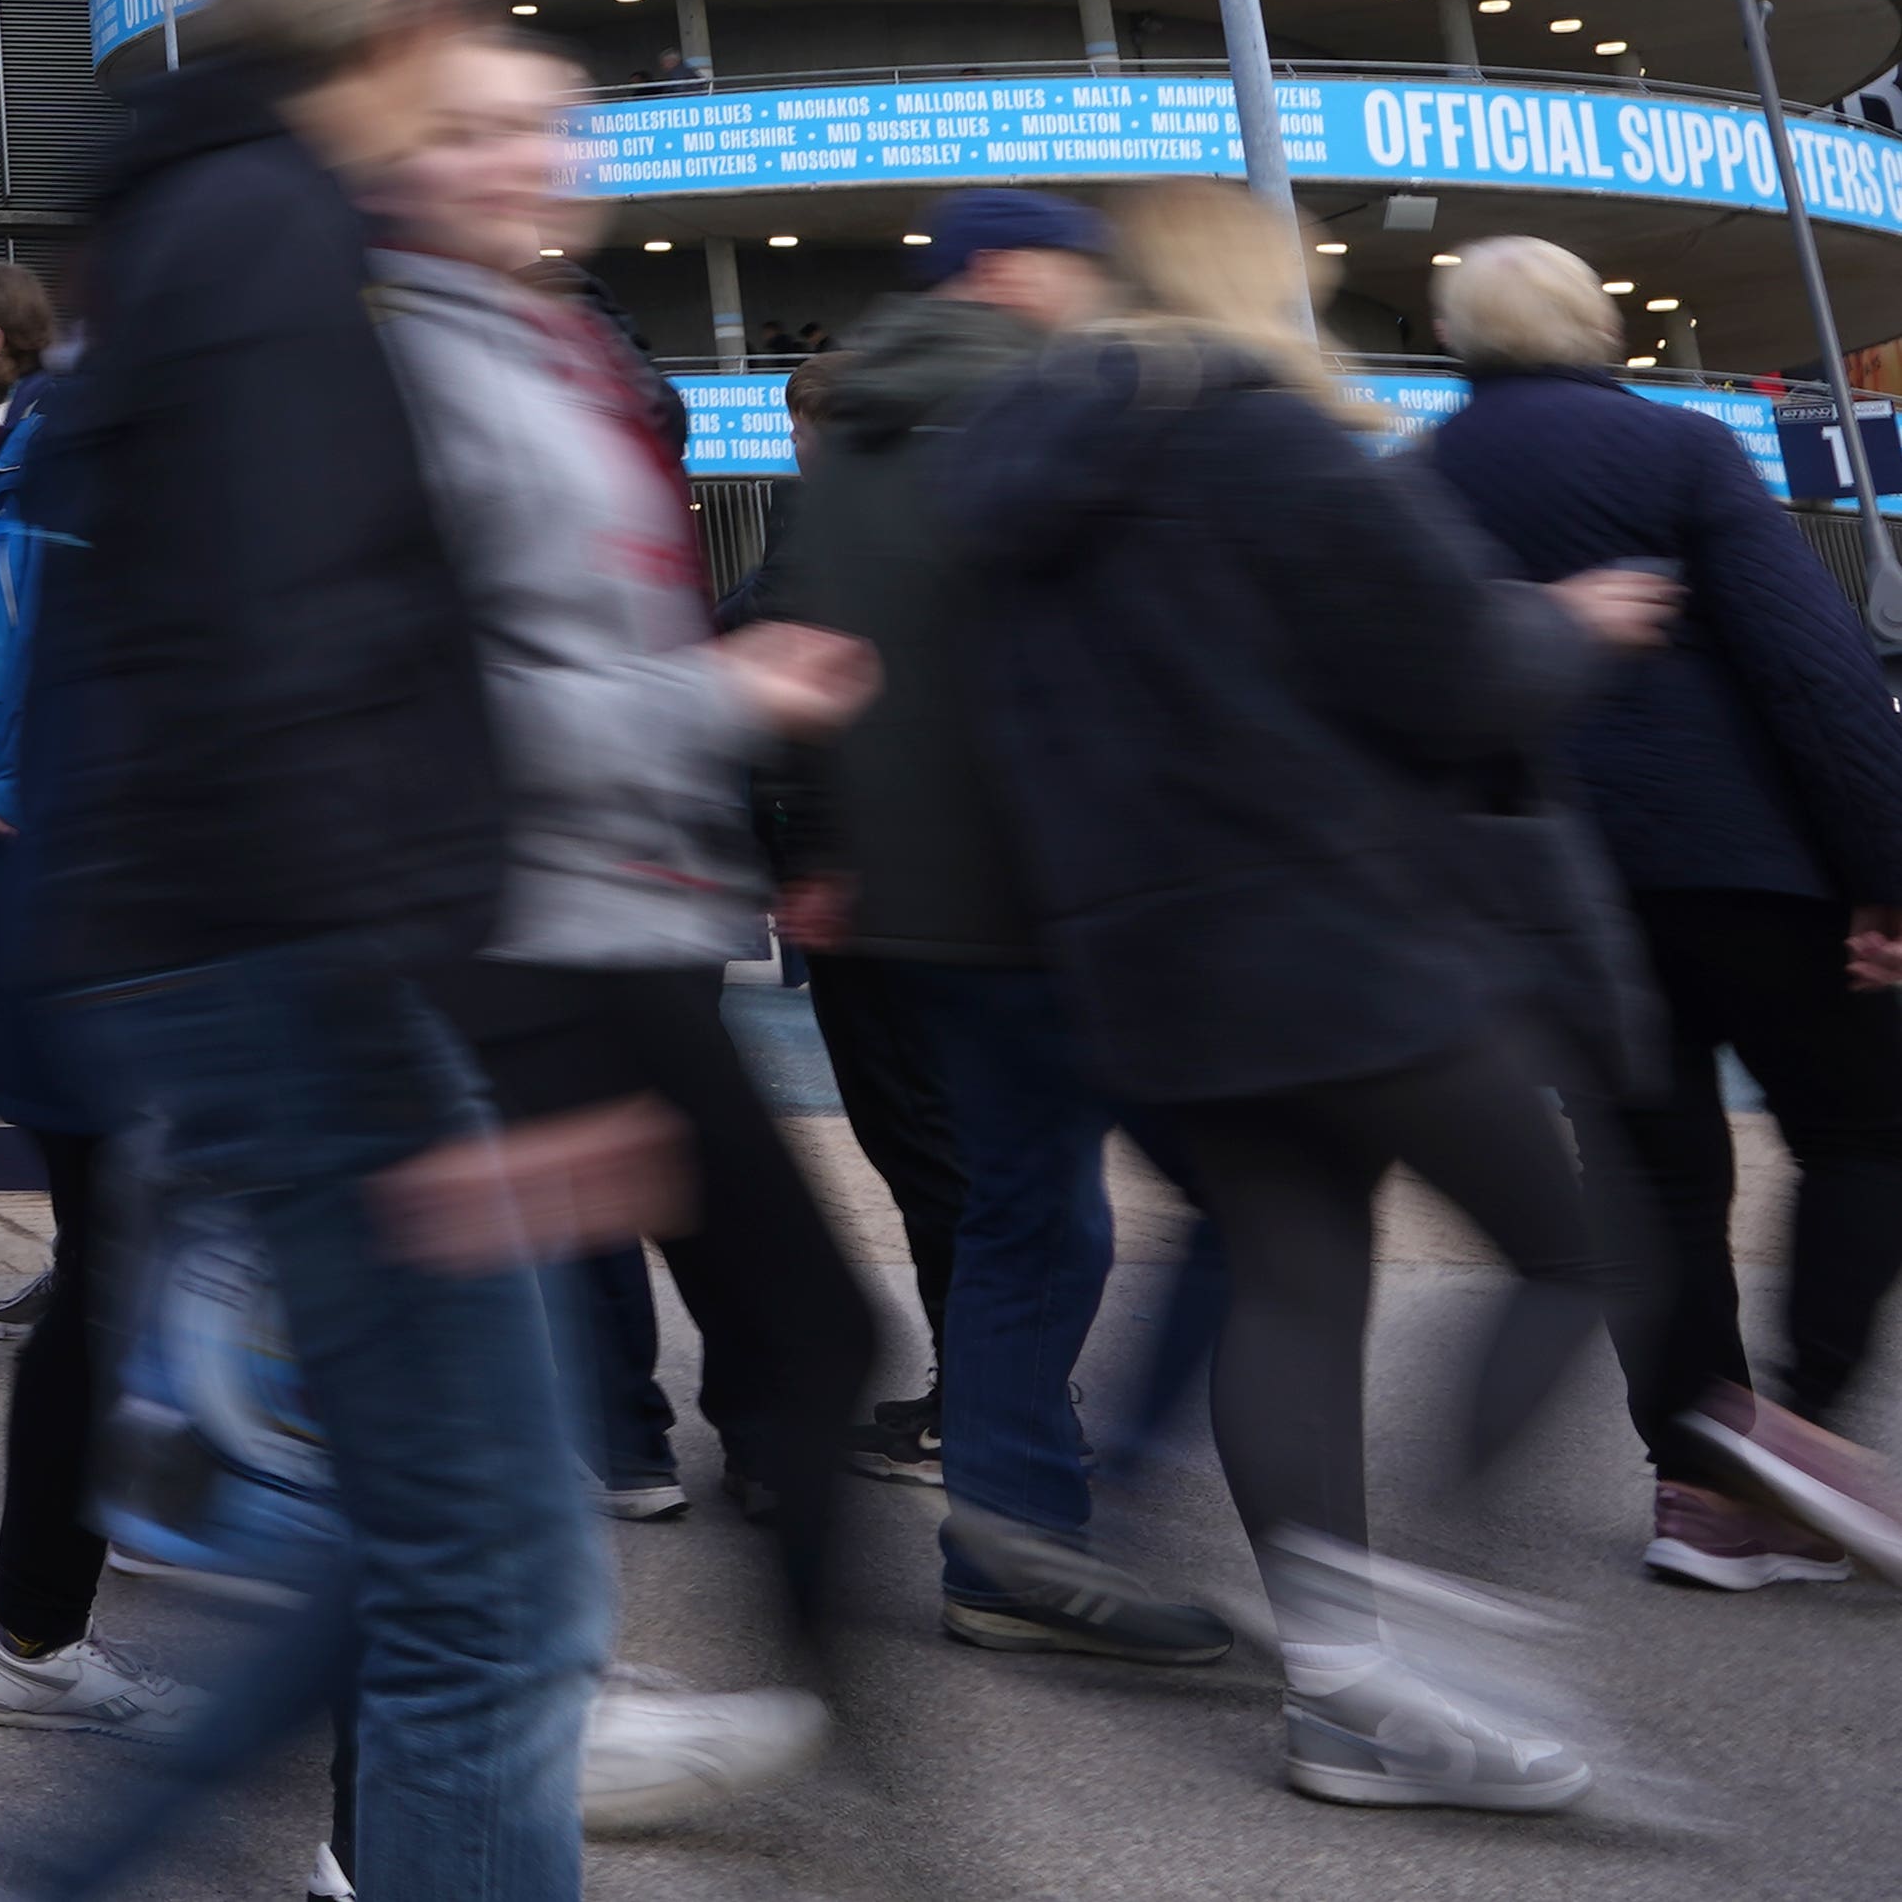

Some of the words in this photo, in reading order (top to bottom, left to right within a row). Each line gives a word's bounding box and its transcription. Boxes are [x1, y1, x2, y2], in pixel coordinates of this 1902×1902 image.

[591, 106, 700, 134] MACCLESFIELD
[704, 103, 752, 127] BLUES
[777, 97, 871, 121] MACHAKOS
[897, 90, 989, 115] MALLORCA
[992, 88, 1046, 110] BLUES
[1072, 85, 1132, 107] MALTA
[622, 135, 655, 159] CITY
[683, 131, 714, 153] MID
[720, 125, 798, 151] CHESHIRE
[827, 122, 862, 144] MID
[1362, 88, 1615, 180] OFFICIAL
[1618, 103, 1884, 220] SUPPOTERS
[1726, 403, 1764, 428] LOUIS
[729, 439, 794, 460] TOBAGO
[1821, 425, 1856, 488] 1
